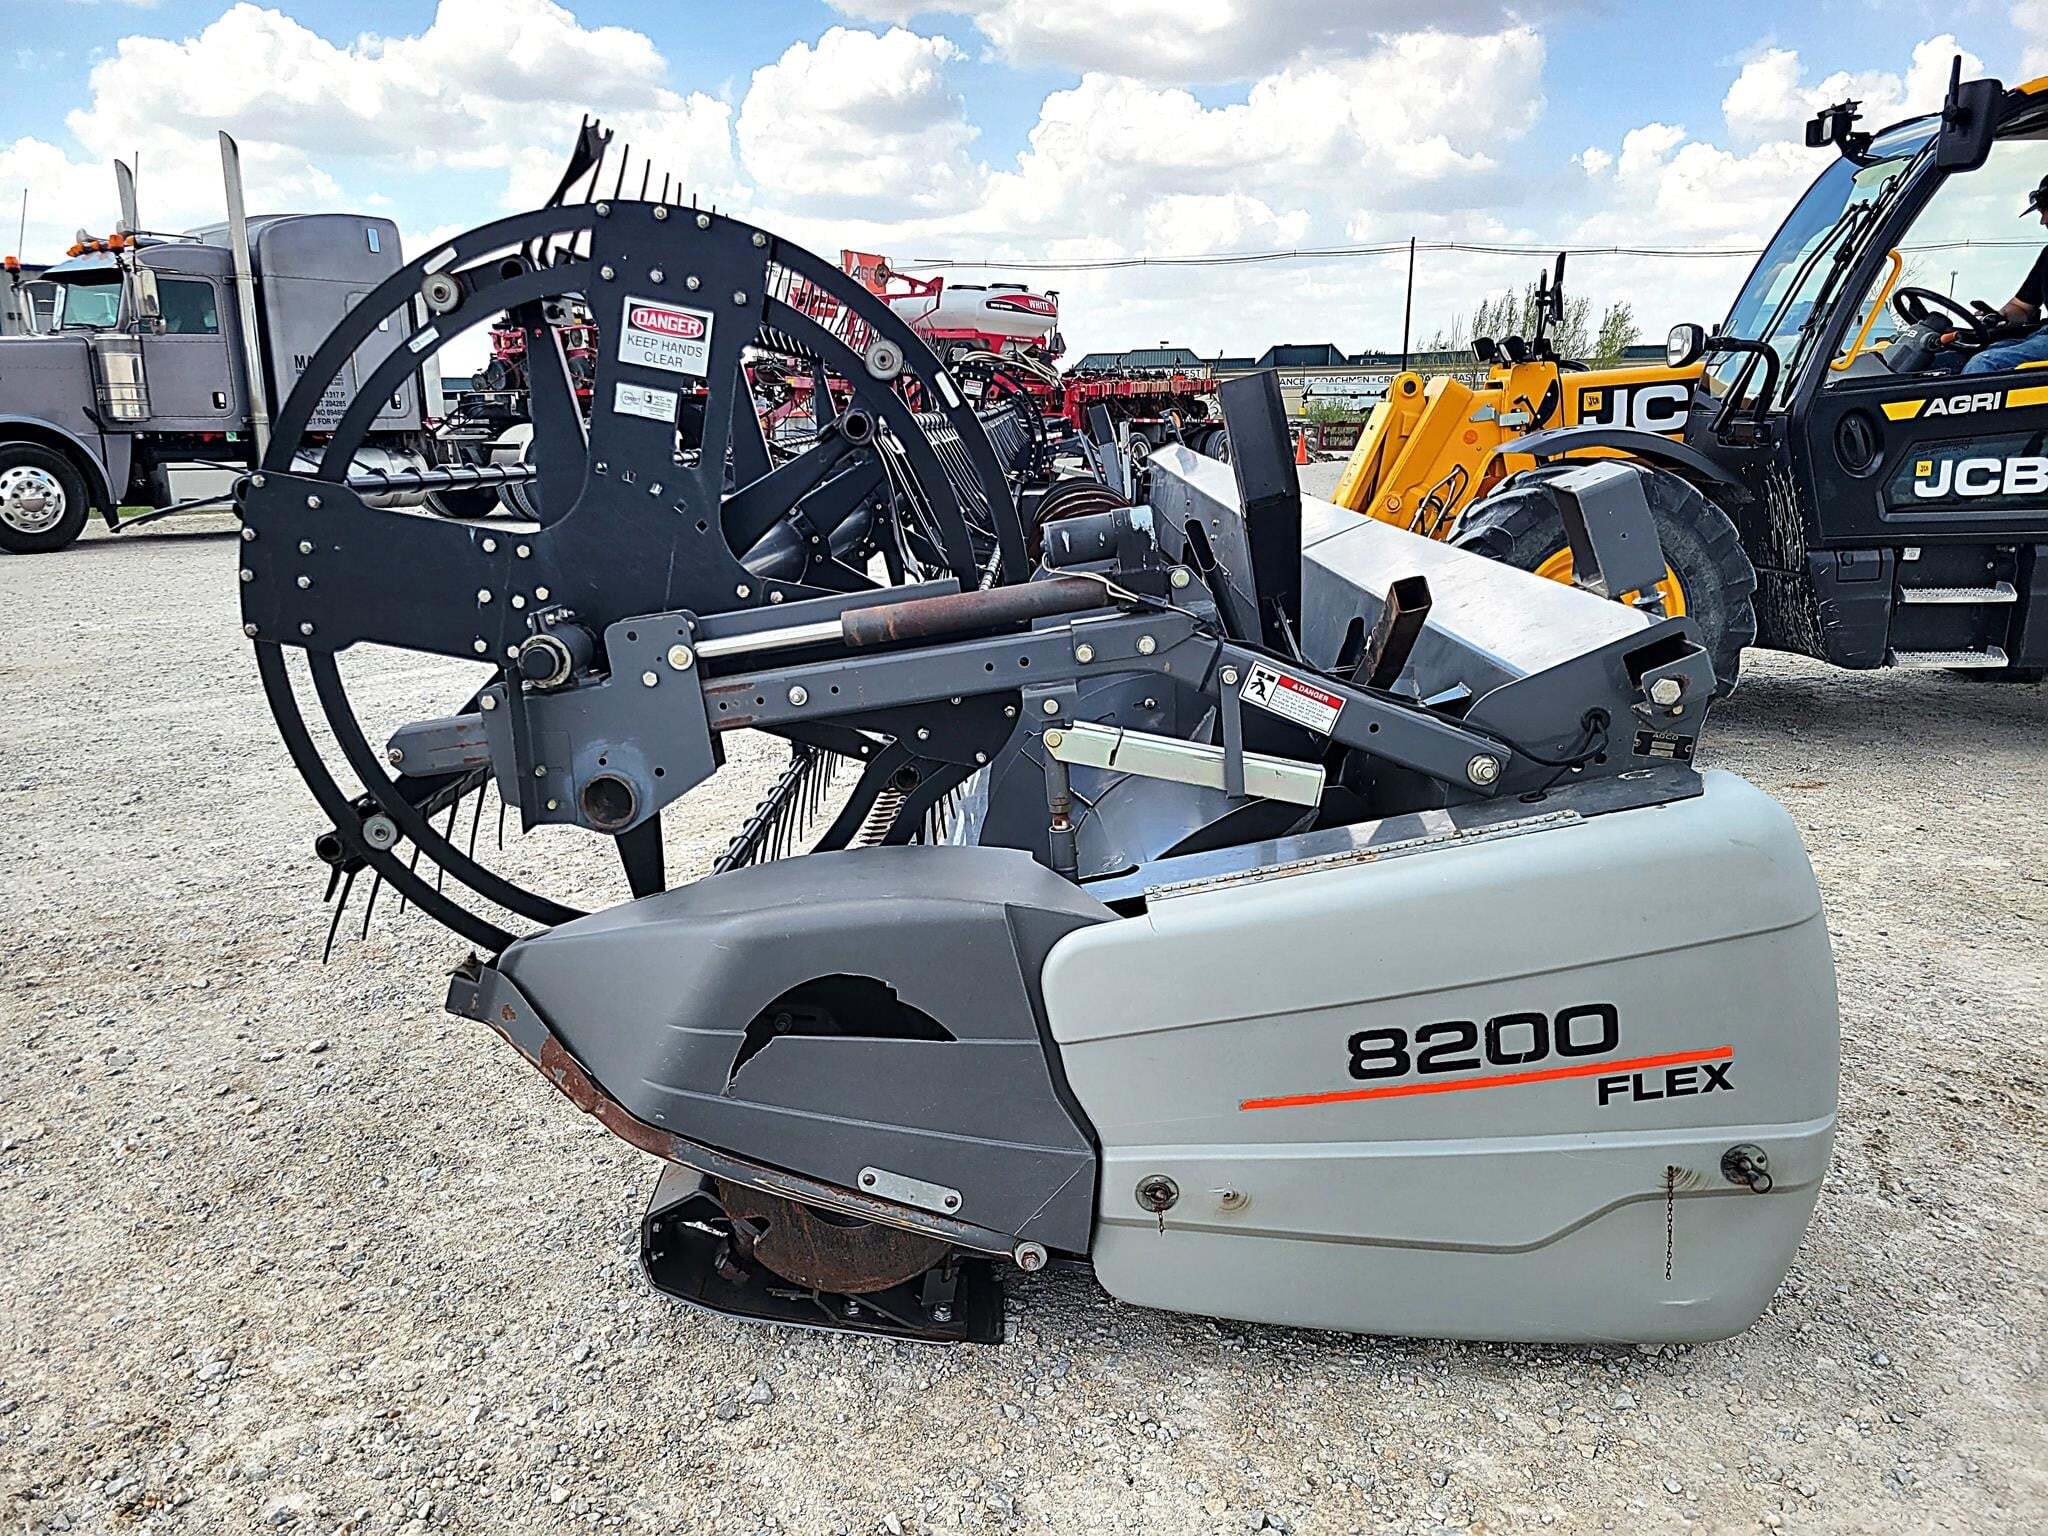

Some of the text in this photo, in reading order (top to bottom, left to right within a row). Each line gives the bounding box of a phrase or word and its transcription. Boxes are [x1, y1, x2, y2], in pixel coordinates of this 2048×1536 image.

[1028, 299, 1050, 312] WHITE
[636, 311, 699, 336] DANGER
[627, 334, 703, 358] KEEP HANDS
[644, 351, 683, 368] CLEAR
[1314, 375, 1370, 385] COACHMEN
[1583, 384, 1690, 433] JC
[1923, 391, 2002, 418] AGRI
[1914, 456, 2048, 498] JCB
[1299, 685, 1329, 703] DANGER
[1347, 1002, 1619, 1080] 8200
[1599, 1061, 1734, 1106] FLEX
